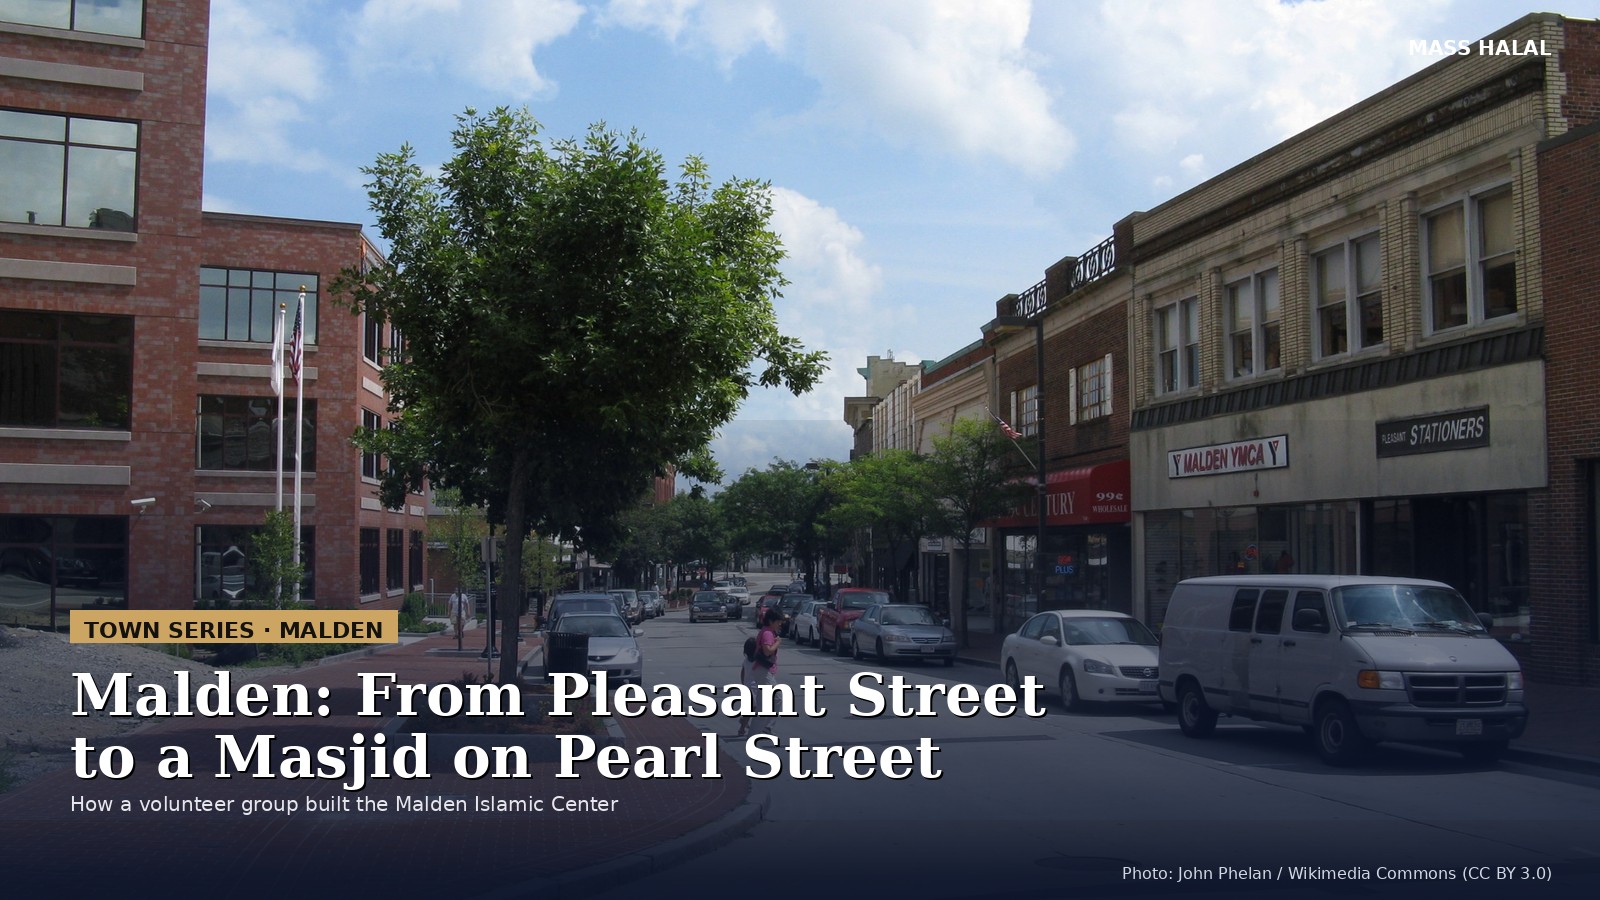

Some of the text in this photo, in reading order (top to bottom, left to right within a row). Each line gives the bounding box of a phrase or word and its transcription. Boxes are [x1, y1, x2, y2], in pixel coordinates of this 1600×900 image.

[1381, 416, 1485, 446] PLEASANT STATIONERS
[1183, 448, 1228, 474] MALDEN
[1231, 443, 1265, 468] YMCA
[1023, 491, 1076, 518] CETURY
[1092, 505, 1129, 513] WHOLESALE
